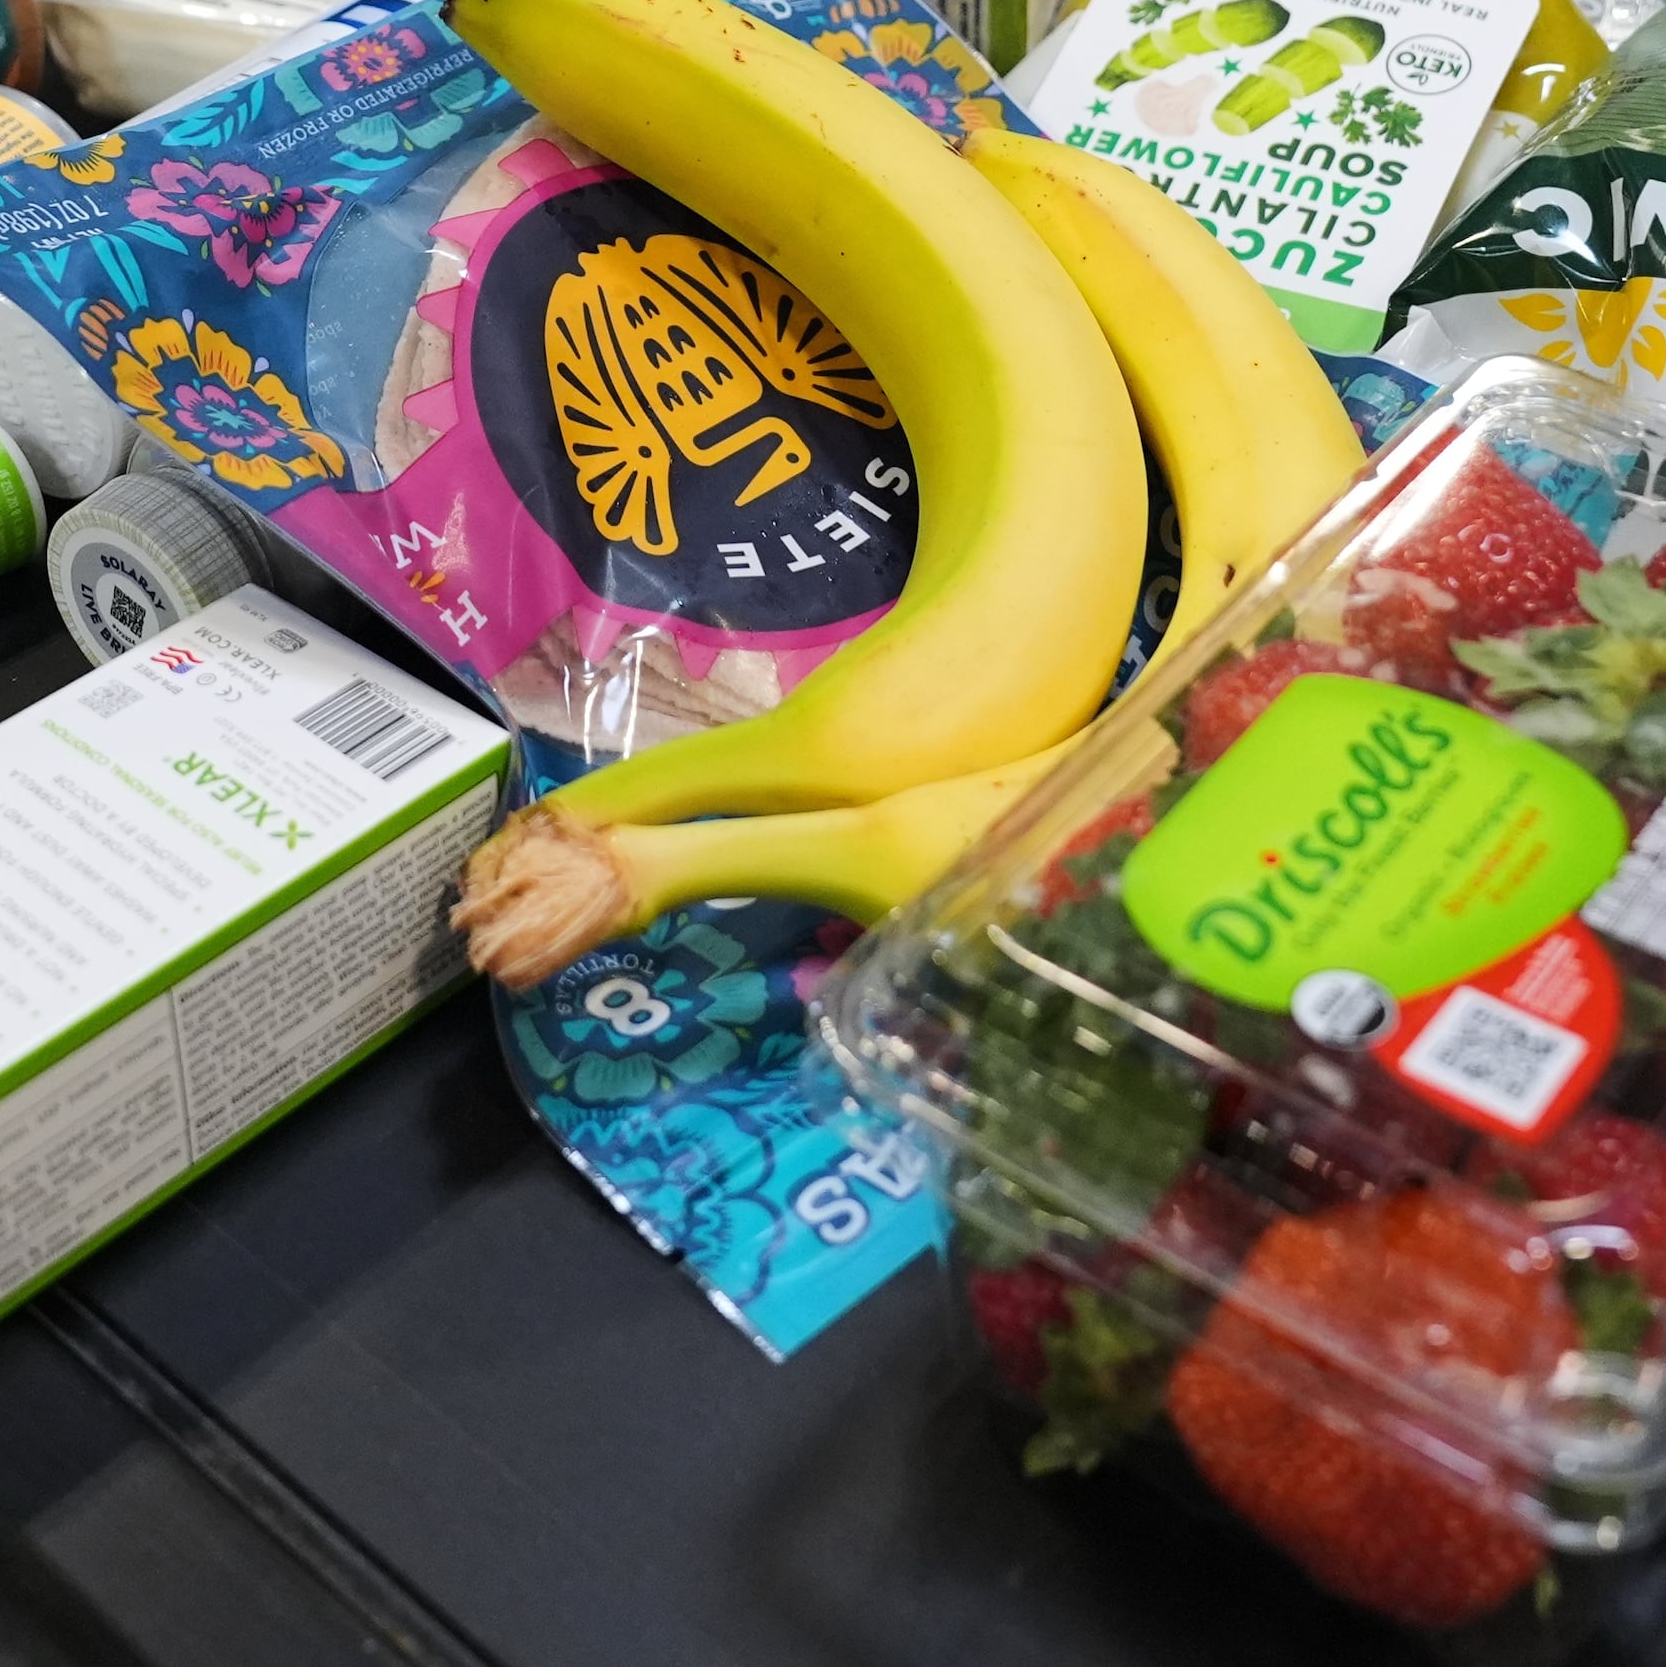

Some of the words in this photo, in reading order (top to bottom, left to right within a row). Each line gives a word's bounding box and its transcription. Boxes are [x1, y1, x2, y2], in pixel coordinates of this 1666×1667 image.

[1439, 0, 1488, 20] REAL
[348, 46, 479, 113] REFRIGERATED
[1394, 49, 1463, 79] KETO
[253, 114, 333, 161] FROZEN
[326, 99, 356, 123] OR
[1060, 122, 1395, 216] CAULIFLOWER
[1264, 133, 1408, 187] SOUP
[46, 197, 90, 224] OZ
[82, 195, 110, 217] 7
[1144, 172, 1379, 248] CILANTR
[717, 456, 911, 578] SIETE
[81, 584, 102, 624] LIVE
[100, 554, 166, 611] SOLARAY
[194, 626, 281, 680] XLEAR.COM
[170, 746, 281, 833] XLEAR
[1189, 705, 1451, 964] Driscoll's
[555, 952, 654, 1013] TORTILLAS
[585, 977, 669, 1036] 8
